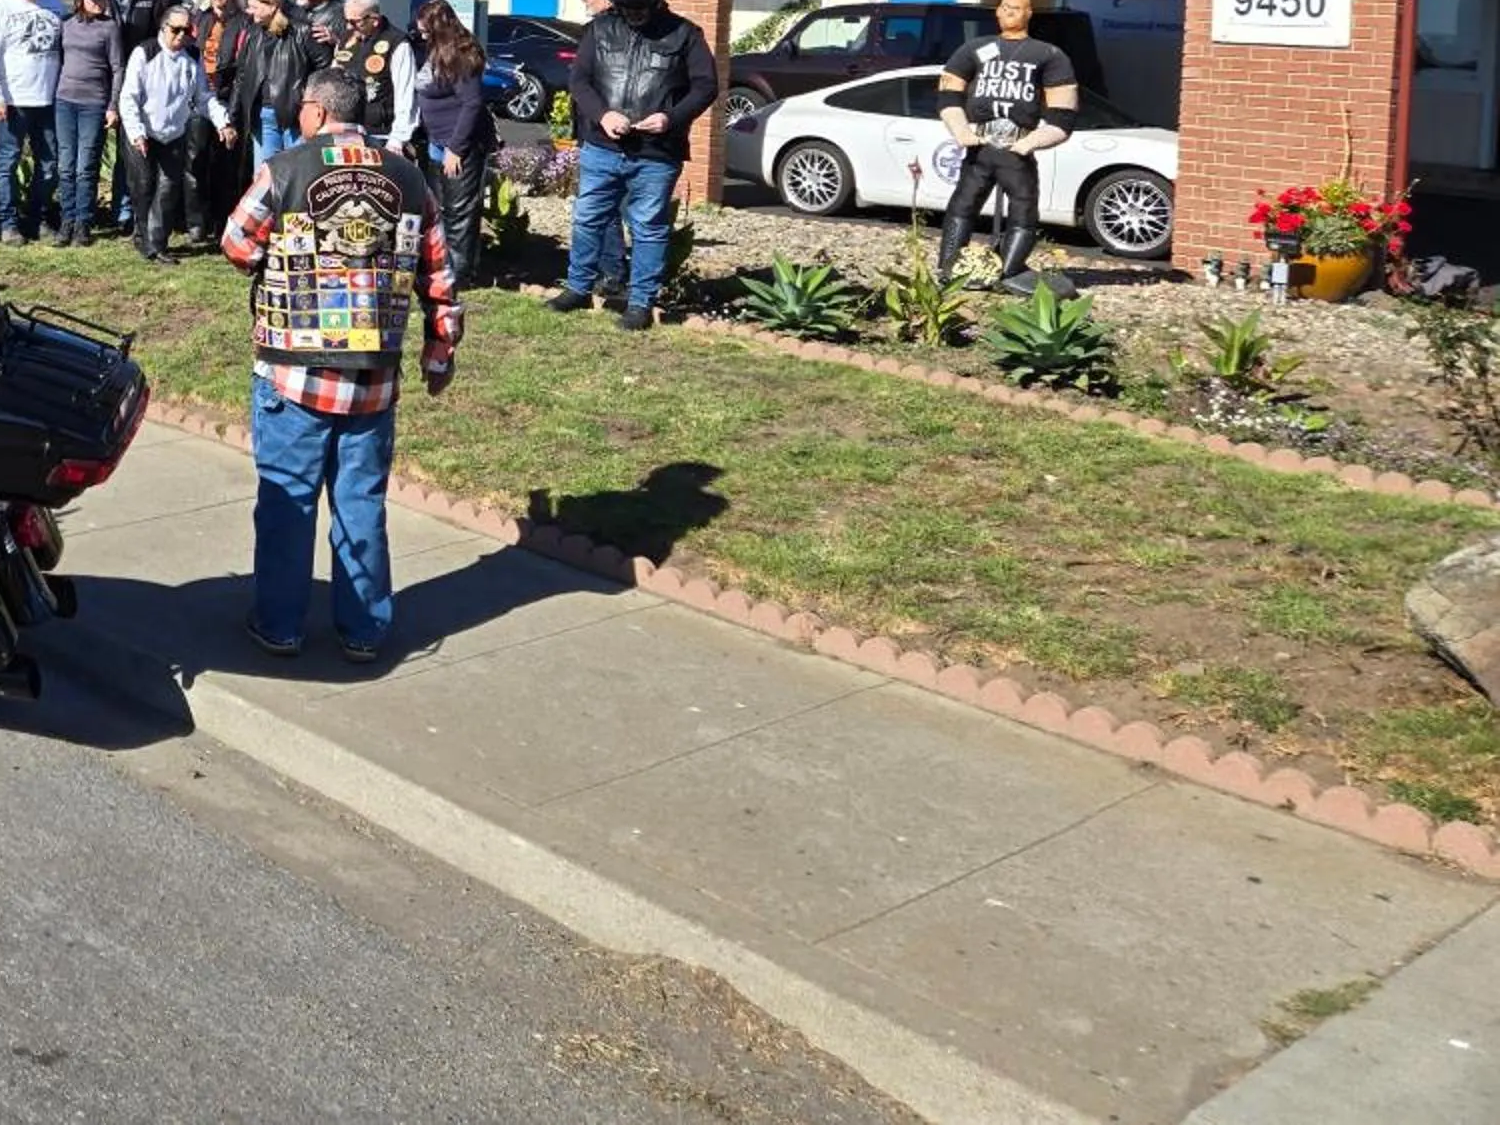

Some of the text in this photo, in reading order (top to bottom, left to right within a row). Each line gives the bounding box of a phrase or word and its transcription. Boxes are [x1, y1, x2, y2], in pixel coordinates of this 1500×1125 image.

[979, 60, 1037, 83] JUST
[974, 77, 1036, 103] BRING
[991, 99, 1015, 119] IT
